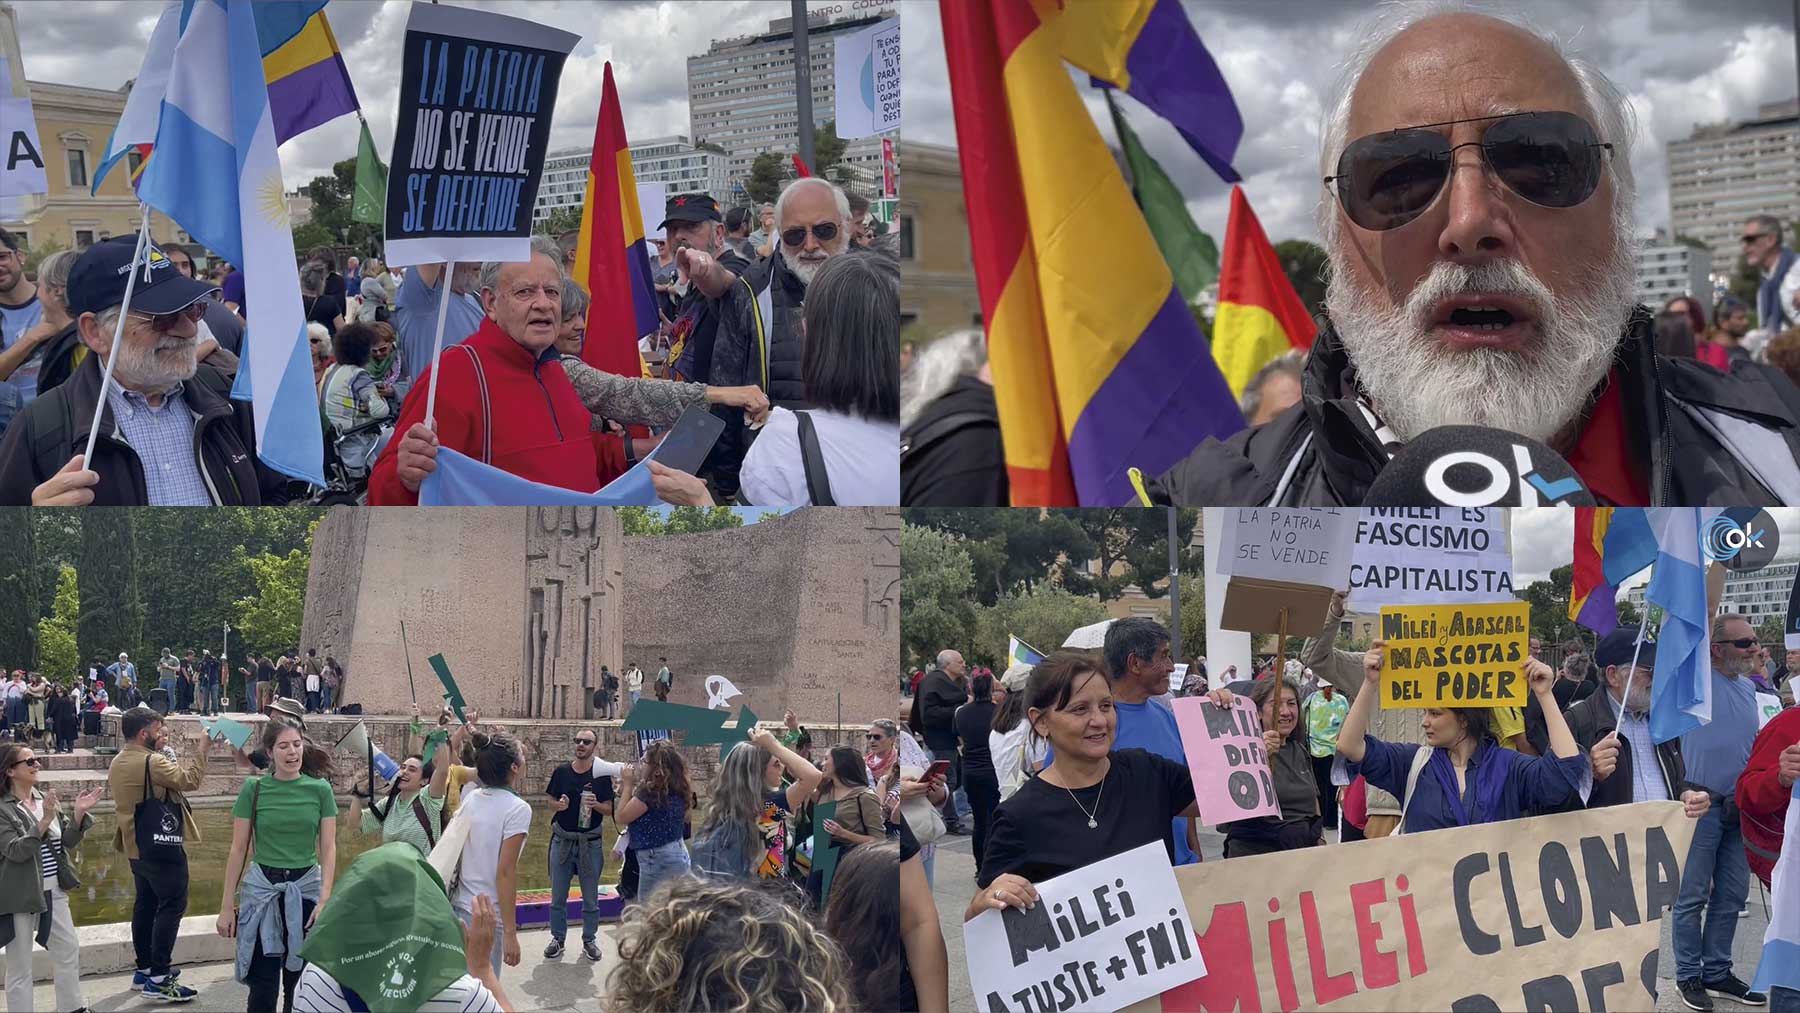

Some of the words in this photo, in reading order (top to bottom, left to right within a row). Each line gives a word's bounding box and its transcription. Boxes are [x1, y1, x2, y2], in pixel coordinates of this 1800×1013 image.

[882, 49, 887, 58] A
[884, 59, 894, 68] TU
[419, 39, 449, 105] LA
[458, 45, 546, 113] PATRIA
[877, 68, 897, 83] PARA
[877, 84, 885, 93] LO
[7, 131, 44, 170] A
[410, 108, 444, 170] NO
[443, 110, 474, 171] SE
[474, 113, 536, 177] VENDE,
[402, 173, 432, 233] SE
[432, 174, 526, 231] DEFIENDE
[1239, 509, 1260, 524] LA
[1461, 507, 1486, 523] ES
[1270, 529, 1297, 544] NO
[1355, 521, 1489, 551] FASCISMO
[1237, 544, 1261, 560] SE
[1271, 547, 1329, 565] VENDE
[1349, 565, 1513, 593] CAPITALISTA
[1450, 611, 1526, 637] ABASCAL
[1391, 642, 1521, 670] MASCOTAS
[1392, 680, 1423, 701] DEL
[1436, 671, 1516, 701] PODER
[1453, 825, 1681, 956] CLONA
[399, 952, 415, 965] VOZ
